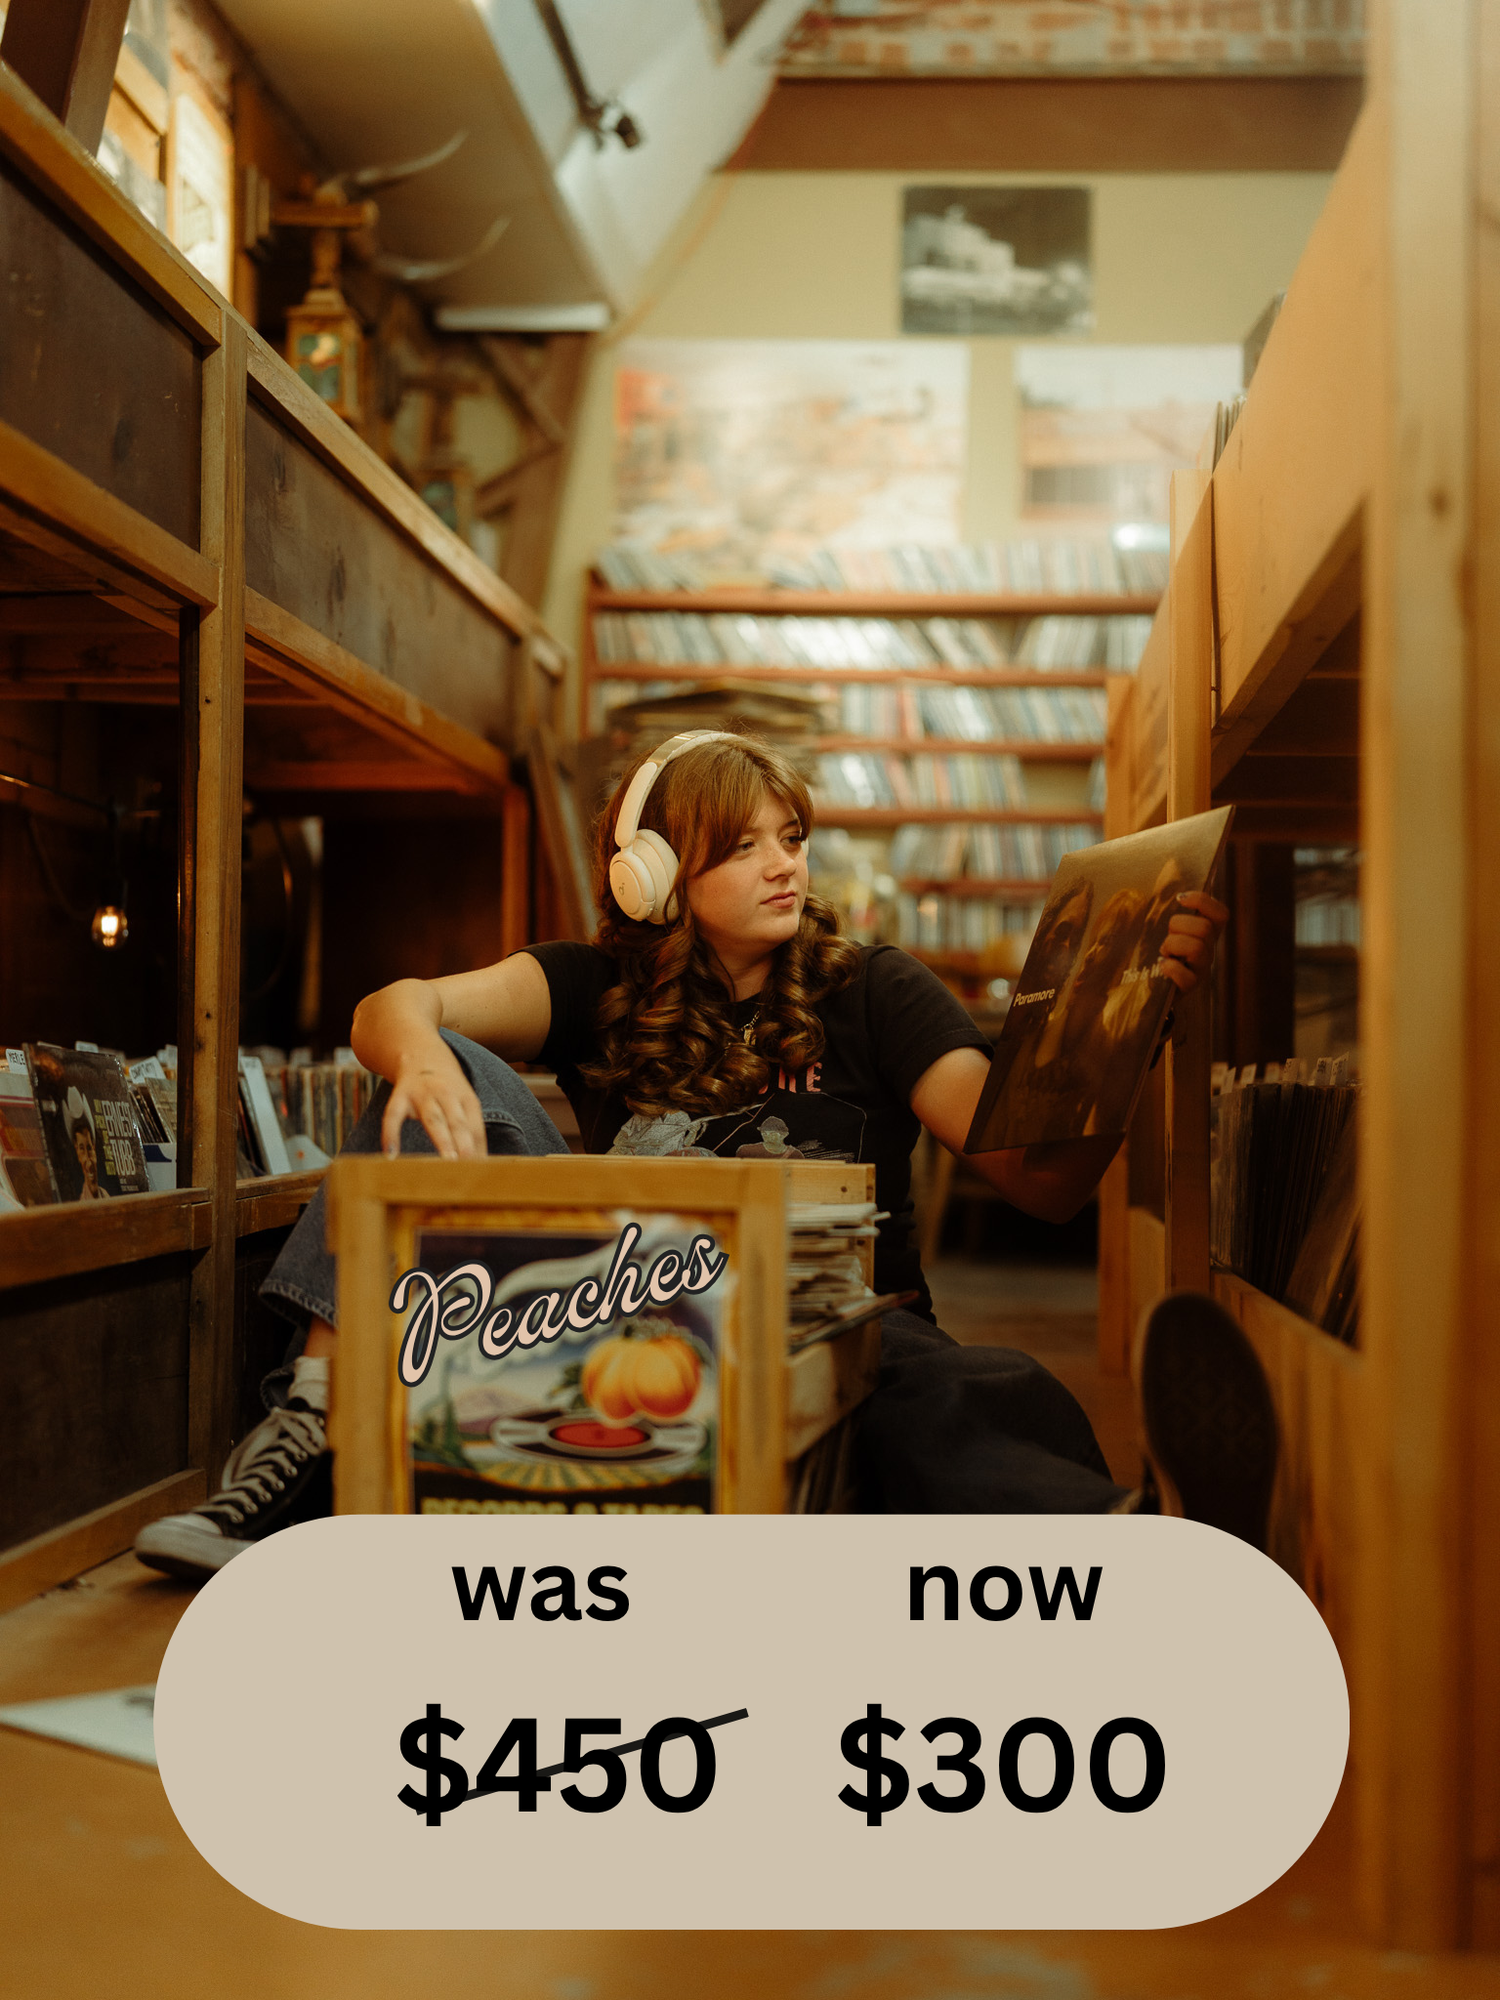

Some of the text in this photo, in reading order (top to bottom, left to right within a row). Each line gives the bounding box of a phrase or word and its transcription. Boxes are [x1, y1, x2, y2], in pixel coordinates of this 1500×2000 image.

[1013, 988, 1056, 1007] Paramore
[101, 1100, 136, 1137] ERNEST
[109, 1139, 136, 1175] TUBB
